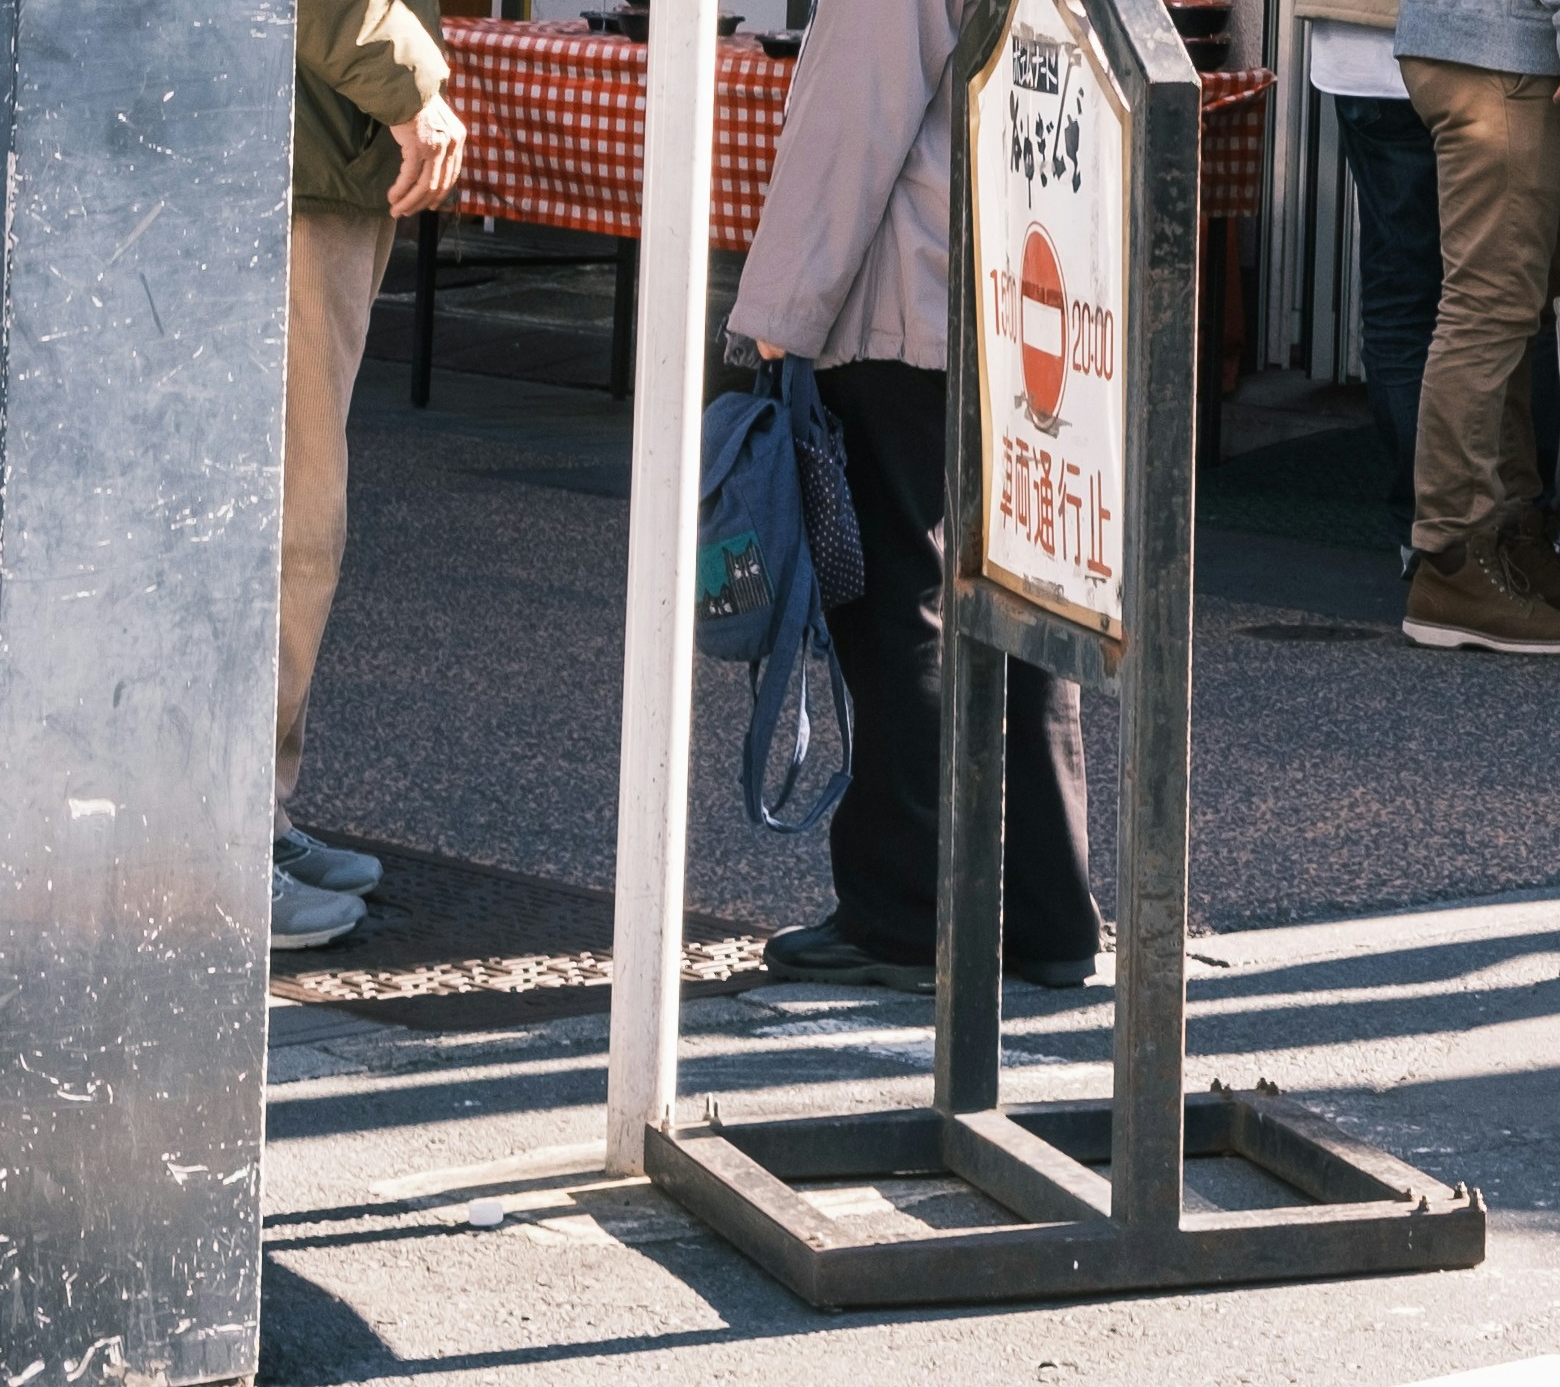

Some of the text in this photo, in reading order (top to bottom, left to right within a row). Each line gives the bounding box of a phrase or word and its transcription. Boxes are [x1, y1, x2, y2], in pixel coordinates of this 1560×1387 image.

[1071, 298, 1115, 381] 20:00
[1000, 430, 1113, 578] 車両通行止
